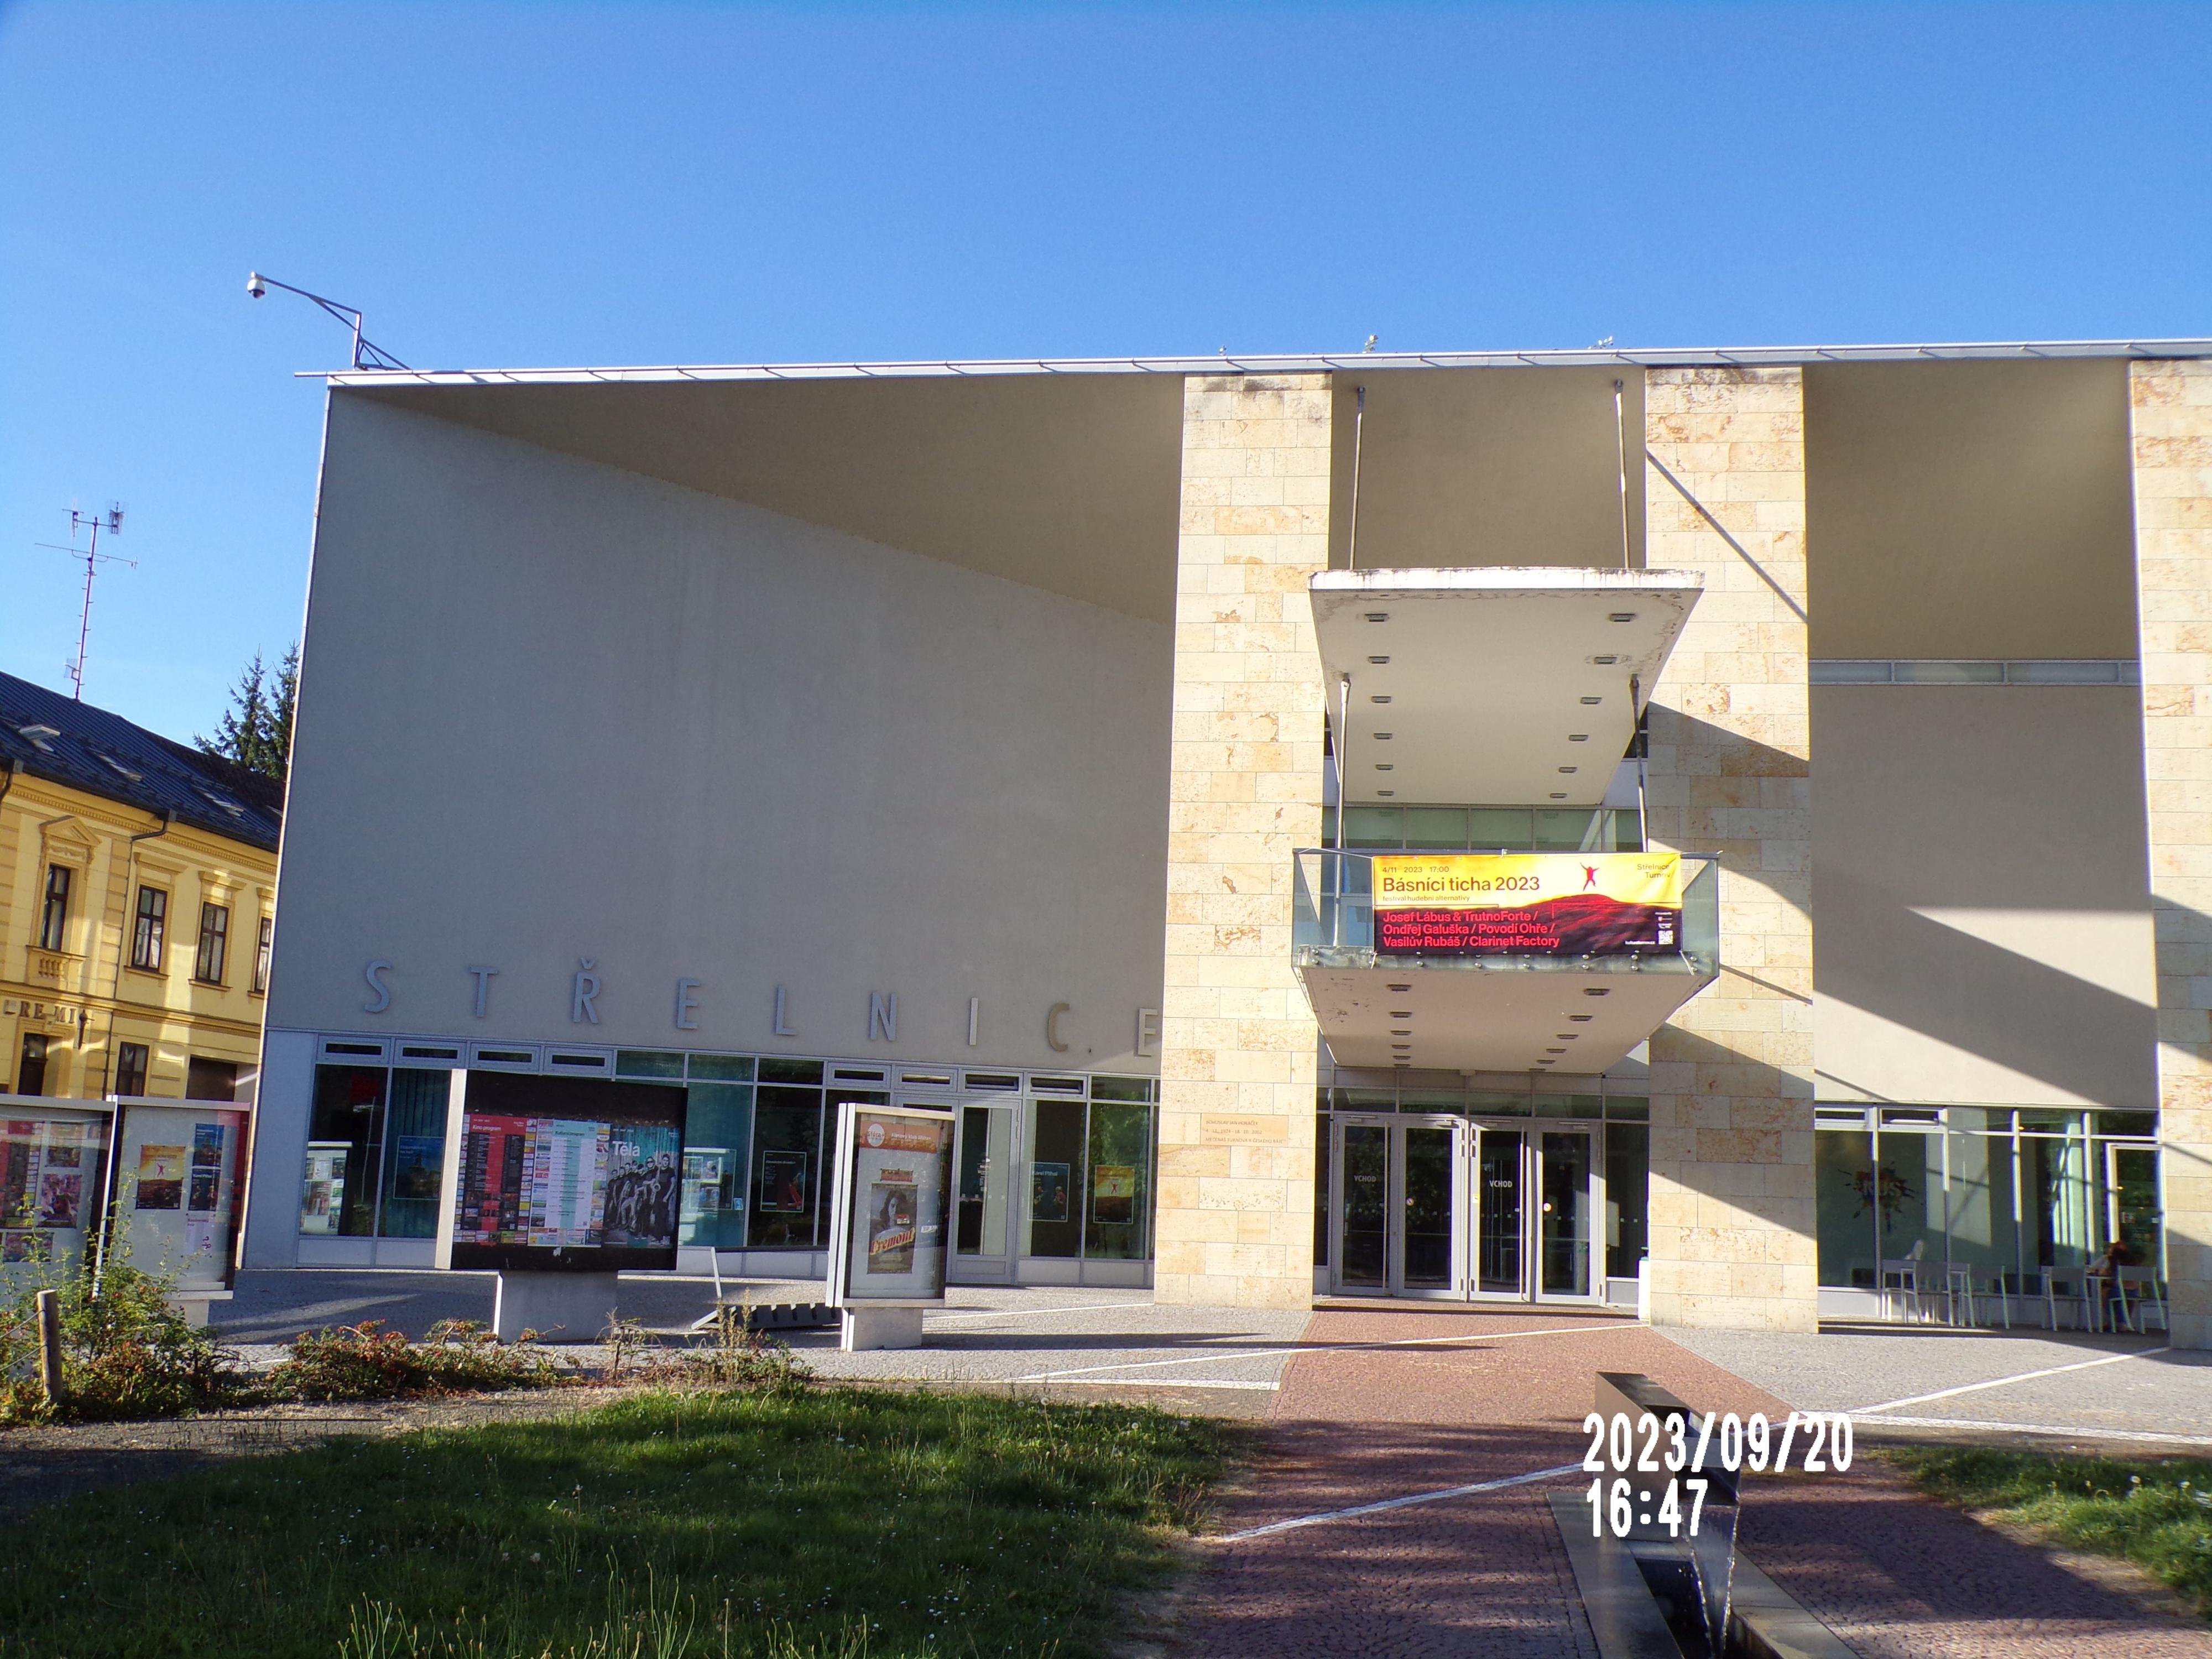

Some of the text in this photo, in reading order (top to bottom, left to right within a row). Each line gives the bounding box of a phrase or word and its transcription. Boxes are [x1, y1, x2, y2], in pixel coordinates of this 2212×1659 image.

[1384, 877, 1540, 891] Básníci ticha 2023
[1384, 911, 1414, 922] Josef
[1417, 911, 1451, 922] Lábus
[1453, 912, 1461, 922] &
[1465, 911, 1531, 922] TrutnoForte
[1384, 924, 1421, 936] Ondřej
[1423, 924, 1469, 935] Galuška
[1479, 923, 1517, 934] Povodí
[1520, 923, 1548, 933] Ohře
[1384, 936, 1423, 947] Vasilův
[1425, 936, 1460, 946] Rubáš
[1469, 936, 1514, 946] Clarinet
[1516, 936, 1559, 948] Factory
[612, 1141, 640, 1157] Těla
